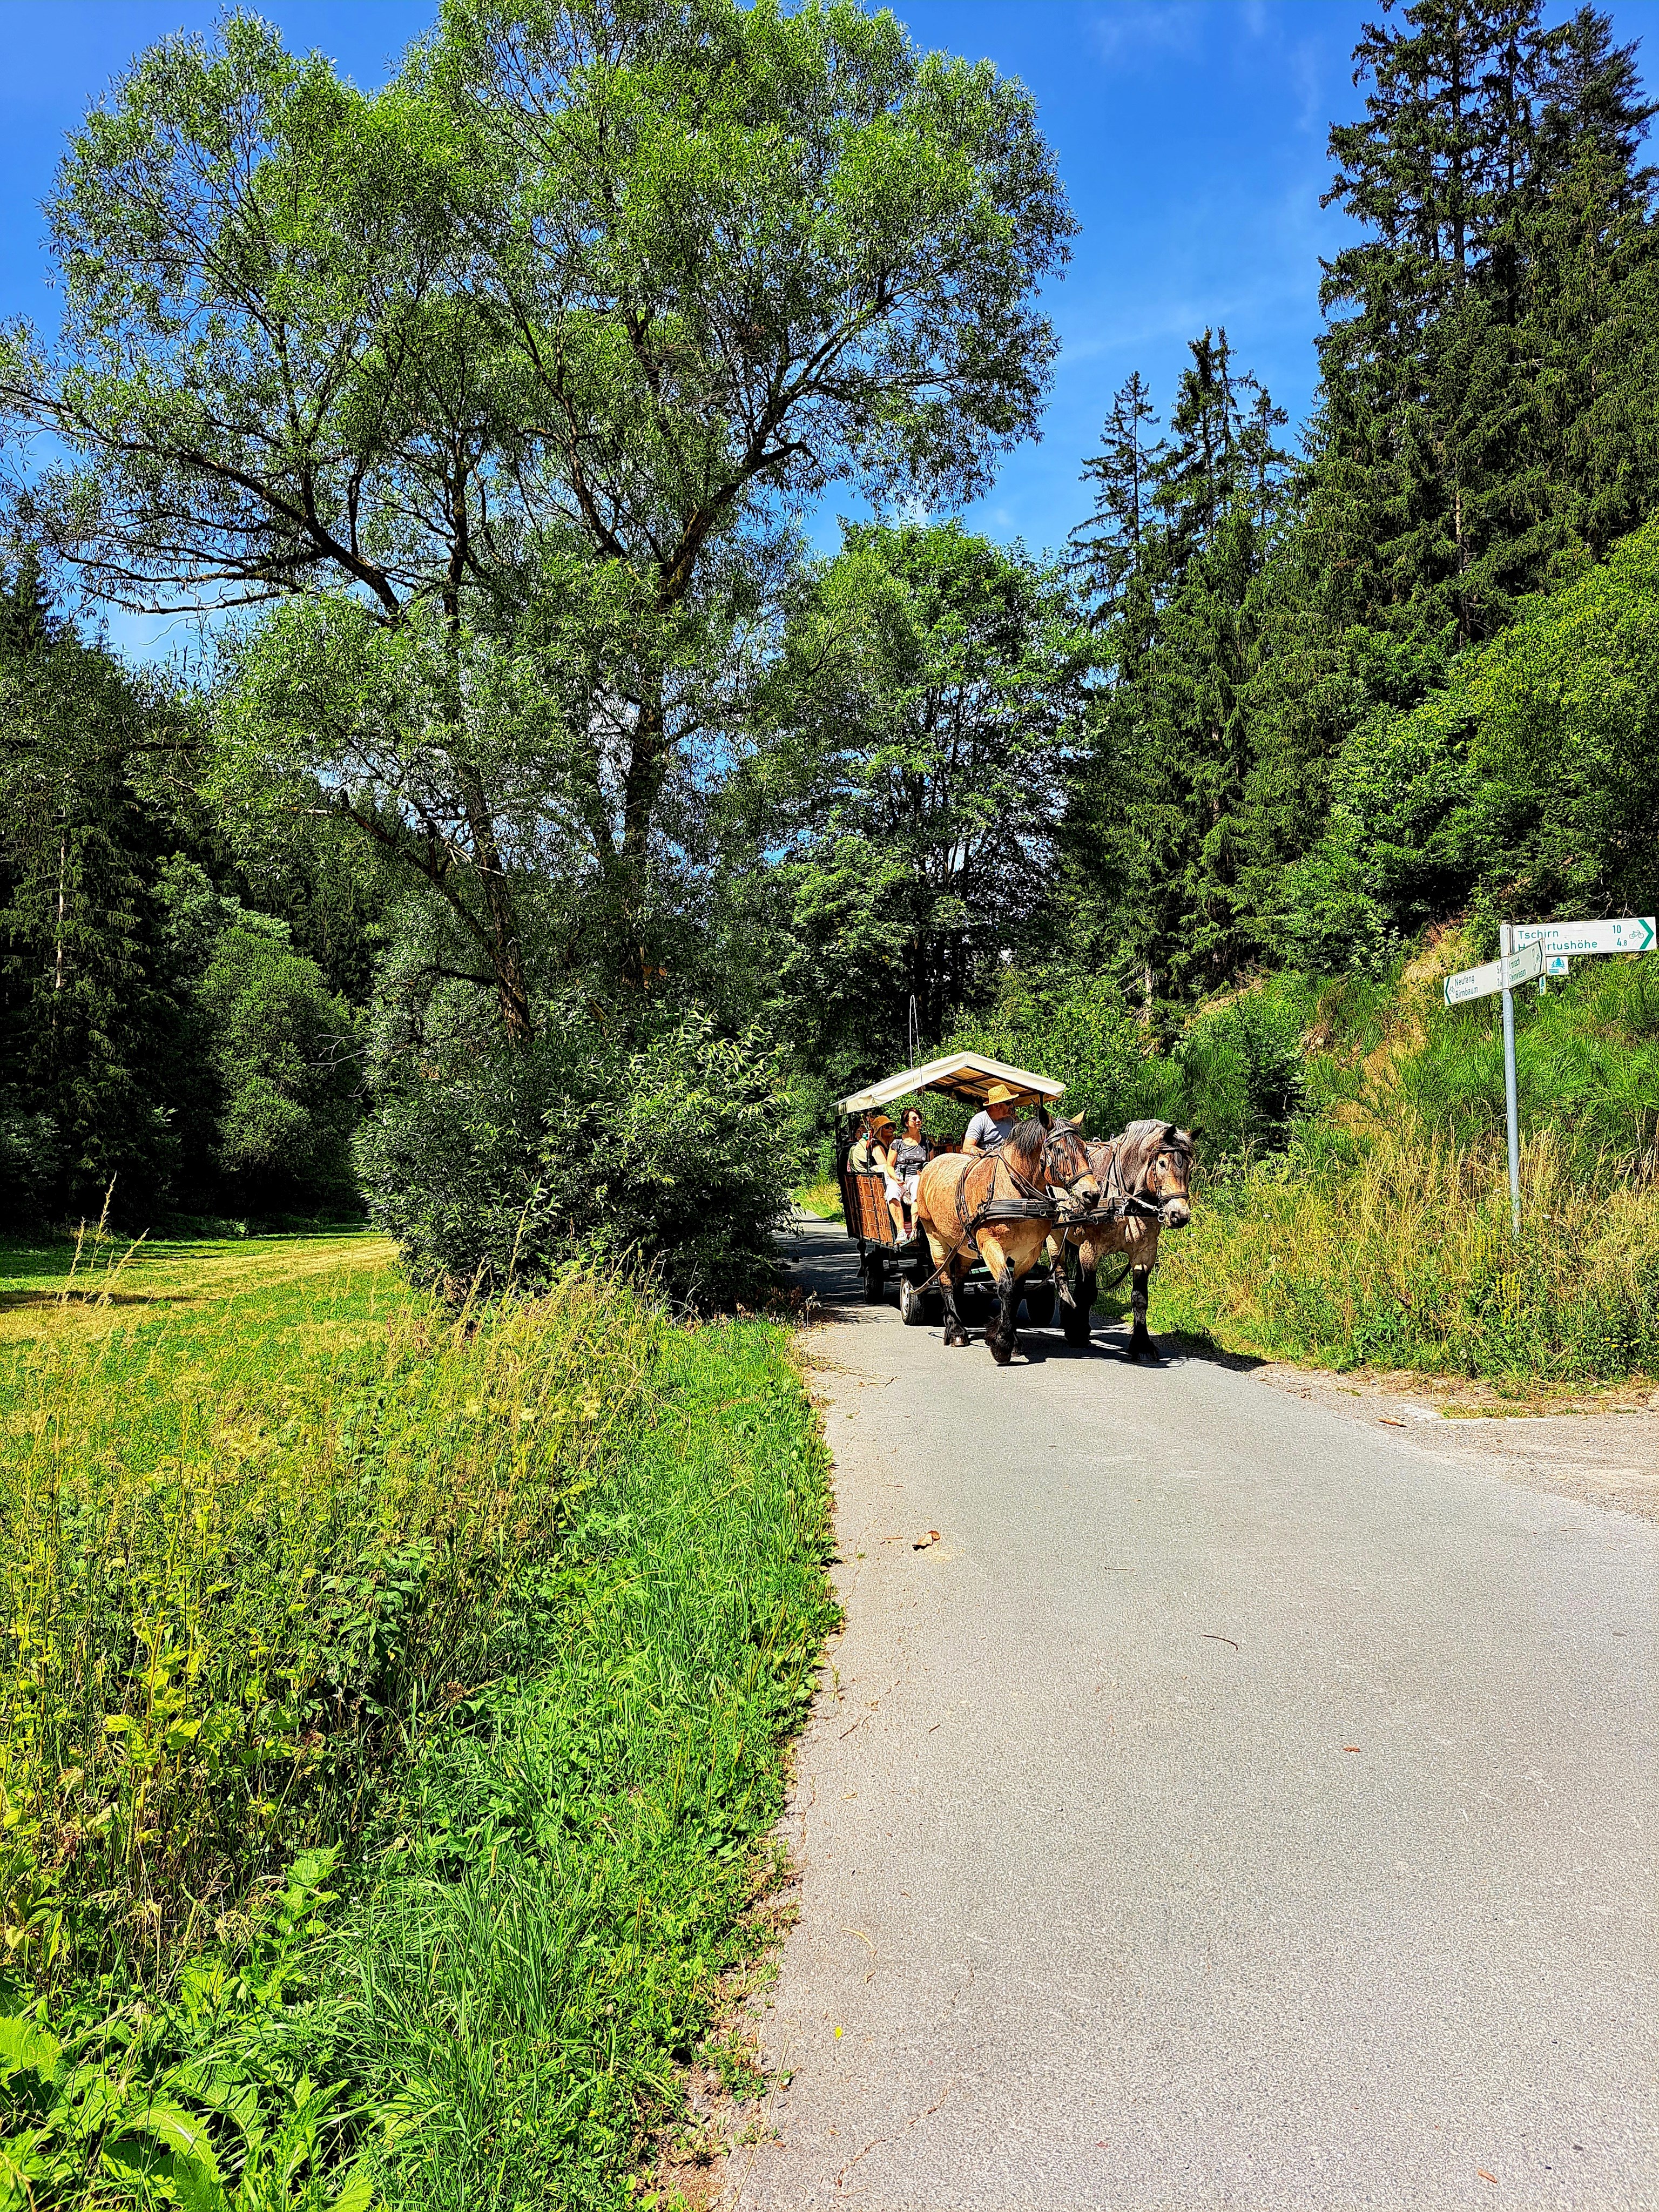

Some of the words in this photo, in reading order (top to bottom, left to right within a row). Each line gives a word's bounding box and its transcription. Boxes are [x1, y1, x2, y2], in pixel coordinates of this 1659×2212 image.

[1518, 929, 1559, 939] Tschirn
[1612, 925, 1621, 934] 10
[1518, 940, 1597, 951] Hrtushöhe
[1455, 975, 1475, 987] Neufang
[1455, 987, 1479, 999] Birnbaum
